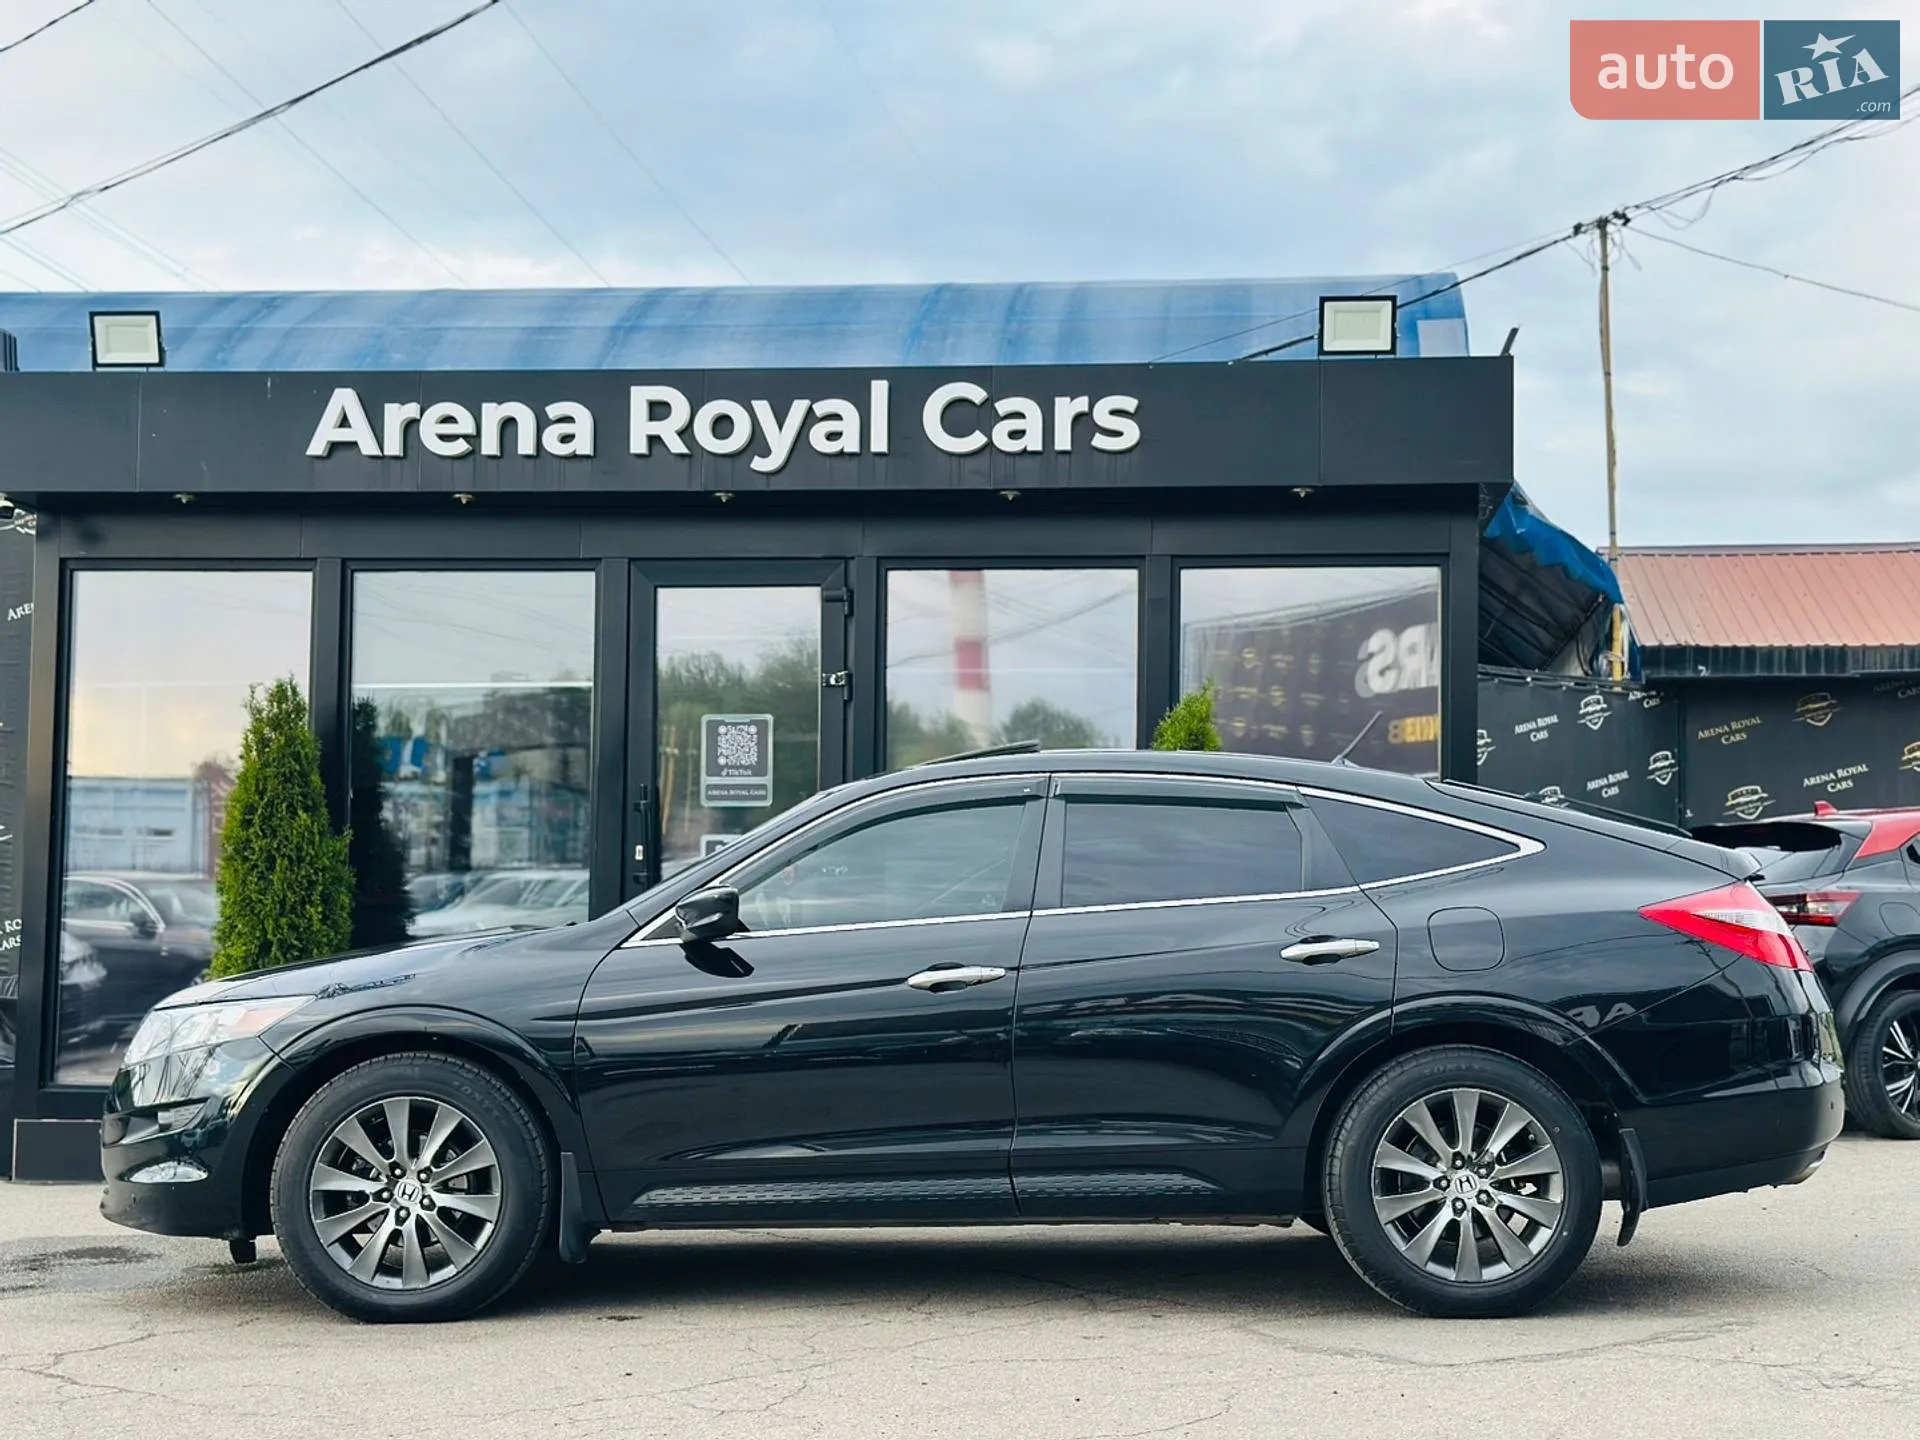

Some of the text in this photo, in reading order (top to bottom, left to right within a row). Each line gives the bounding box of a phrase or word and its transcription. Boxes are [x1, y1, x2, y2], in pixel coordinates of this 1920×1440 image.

[305, 379, 1141, 474] Arena Royal Cars
[1514, 714, 1559, 734] ARENA ROYAL
[1697, 716, 1762, 739] ARENA ROYAL
[1530, 730, 1549, 742] CARS
[1721, 732, 1747, 744] CARS
[1586, 770, 1629, 791] ARENA ROYAL
[1803, 764, 1868, 787] ARENA ROYAL
[1601, 786, 1619, 798] CARS
[1827, 780, 1853, 792] CARS
